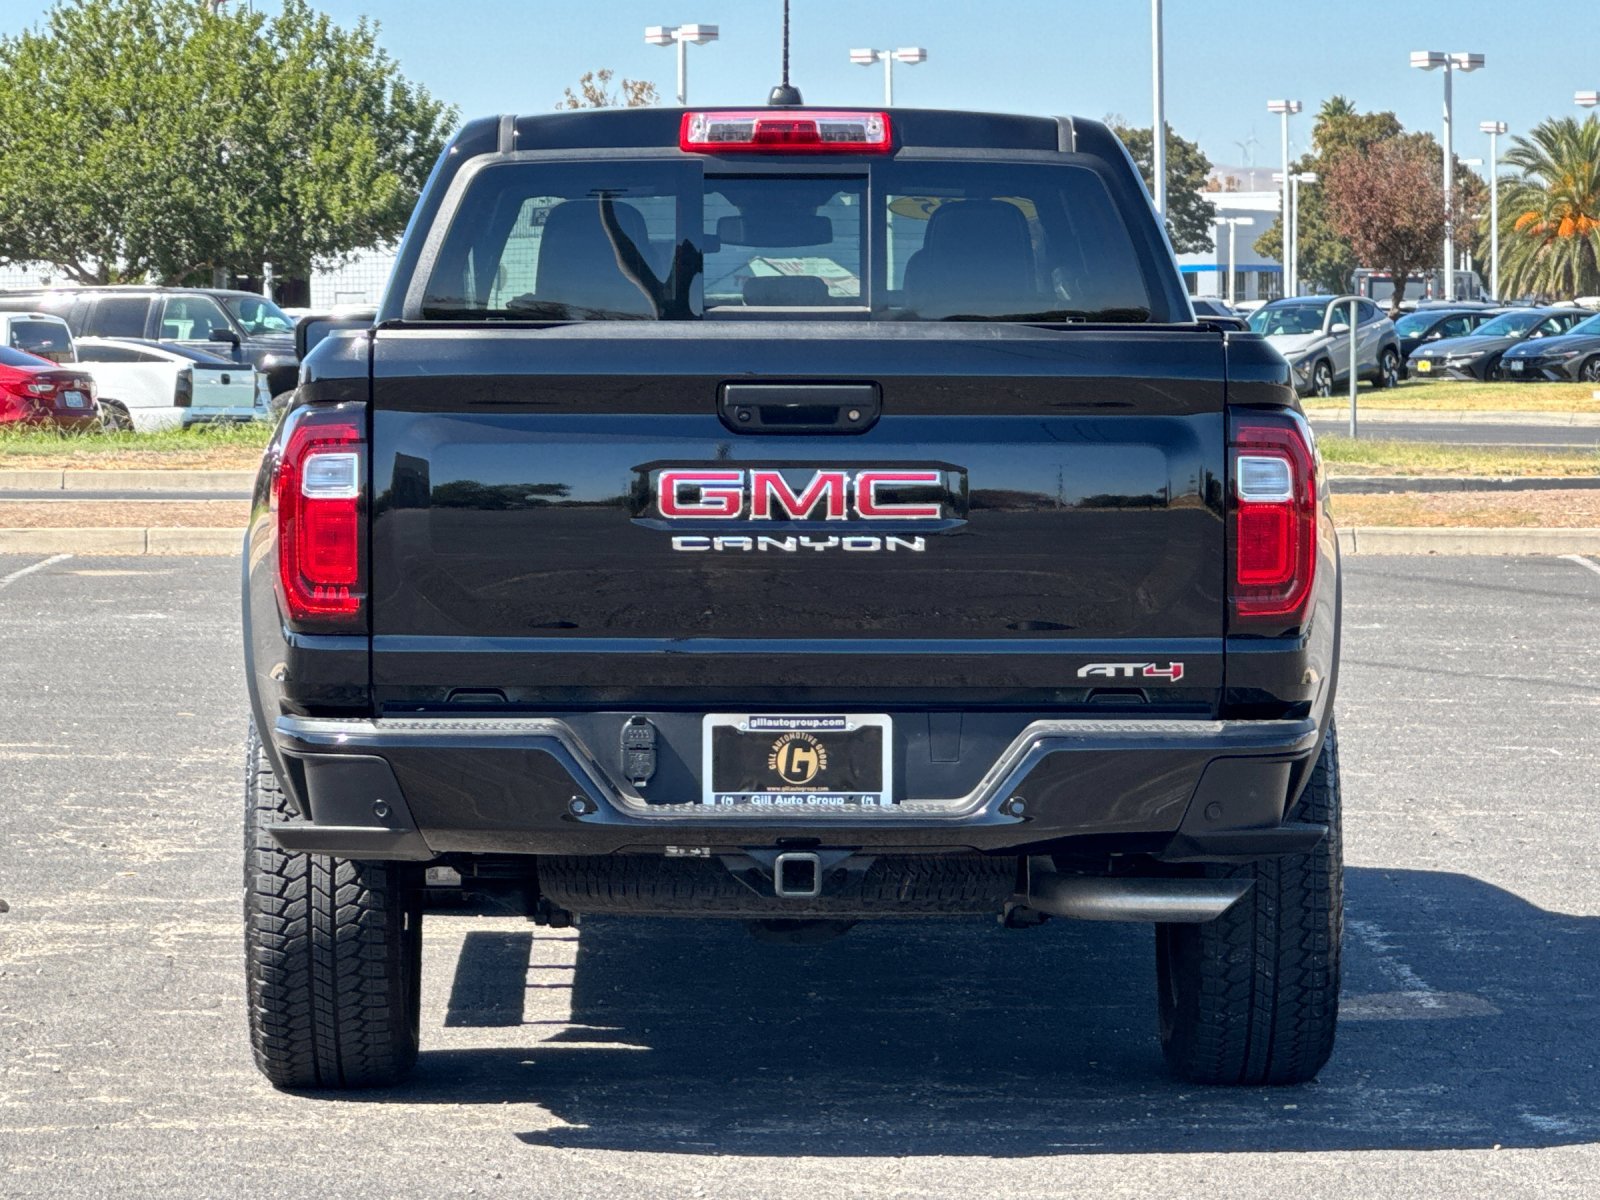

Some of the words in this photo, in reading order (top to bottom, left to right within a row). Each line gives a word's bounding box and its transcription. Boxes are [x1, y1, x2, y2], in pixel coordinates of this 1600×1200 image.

[658, 469, 941, 520] GMC
[671, 536, 926, 551] CANYON
[1077, 662, 1184, 682] AT4
[750, 718, 845, 728] gillautogroup.com
[772, 732, 818, 752] AUTOMOTIVE
[768, 753, 777, 770] GILL
[815, 744, 827, 770] GROUP
[751, 795, 772, 805] Gill
[775, 795, 804, 805] Auto
[806, 795, 845, 805] Group
